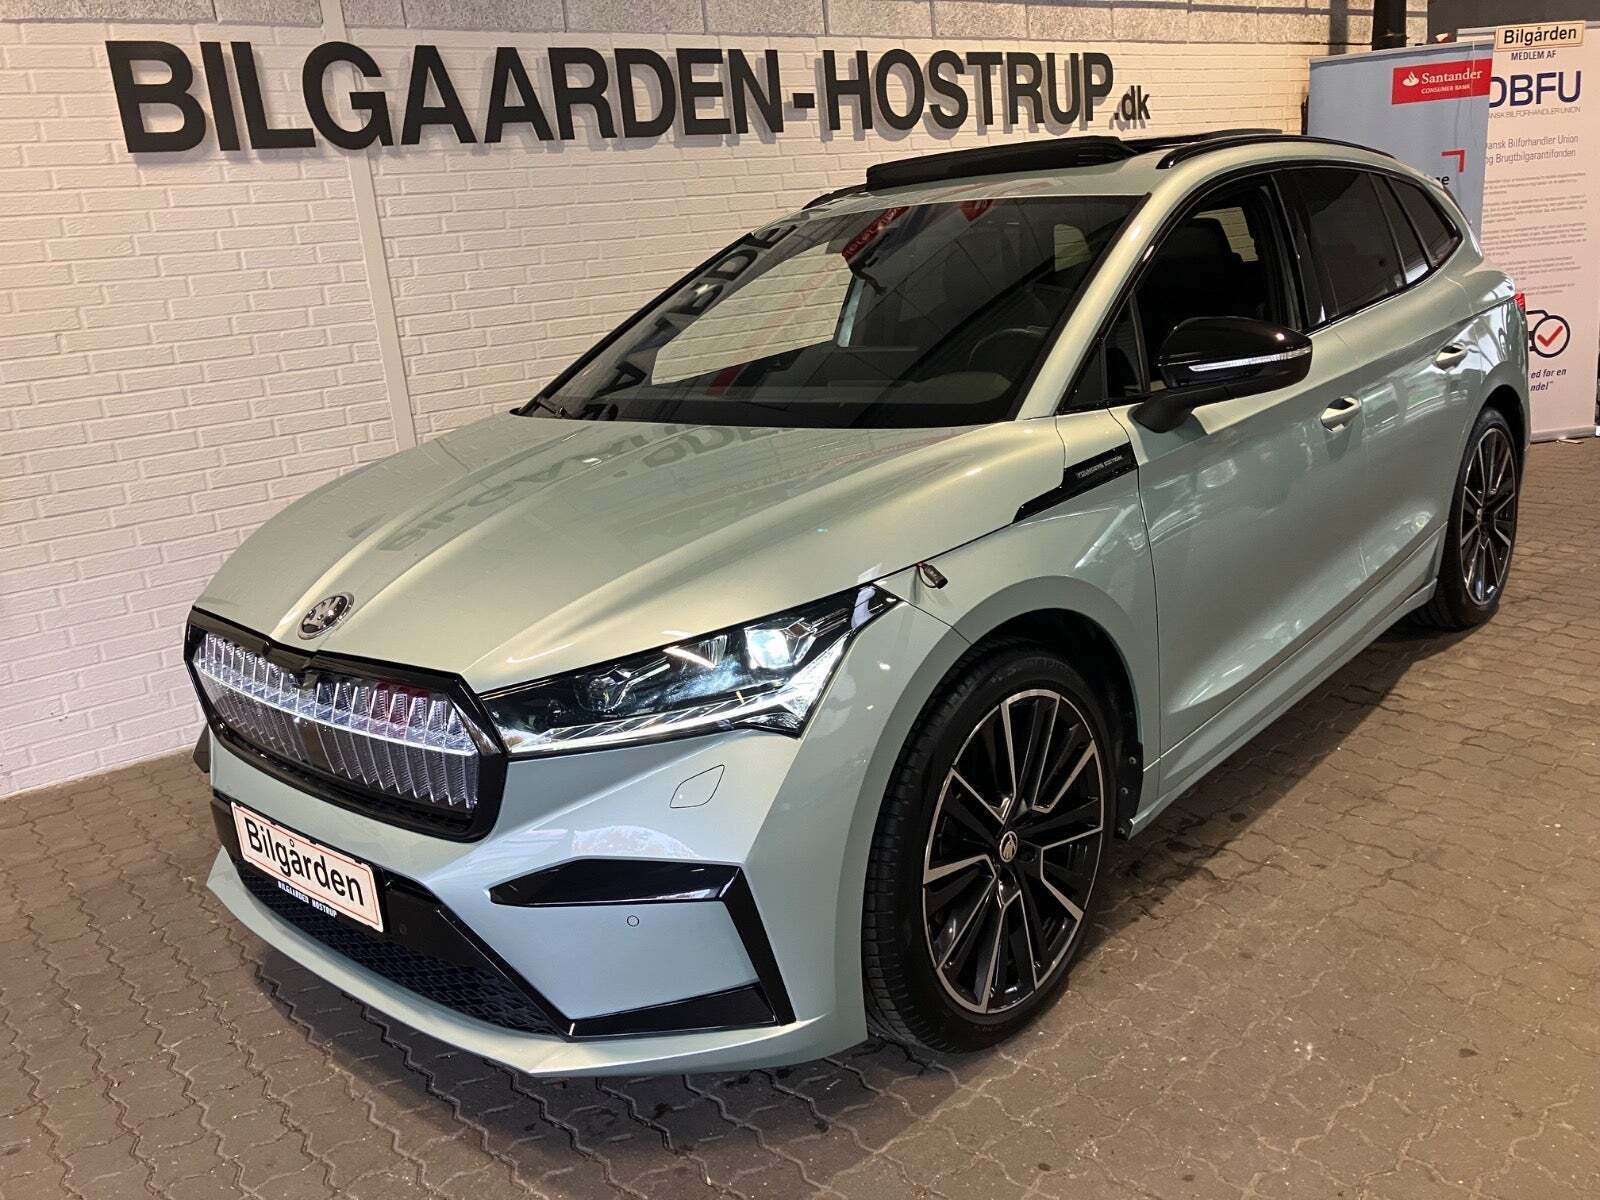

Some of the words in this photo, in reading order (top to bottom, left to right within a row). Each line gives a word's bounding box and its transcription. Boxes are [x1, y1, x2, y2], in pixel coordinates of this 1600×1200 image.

[1503, 25, 1577, 47] Bilgården
[1510, 51, 1545, 61] MEDLEM
[1546, 50, 1557, 59] AF
[1421, 67, 1483, 85] Santander
[1420, 85, 1454, 95] CONSUMER
[1455, 84, 1471, 92] BANK
[1487, 139, 1506, 150] ansk
[1507, 136, 1557, 149] Bilforhandler
[1557, 134, 1579, 145] Union
[1556, 368, 1567, 377] en
[244, 817, 365, 906] Bilgården
